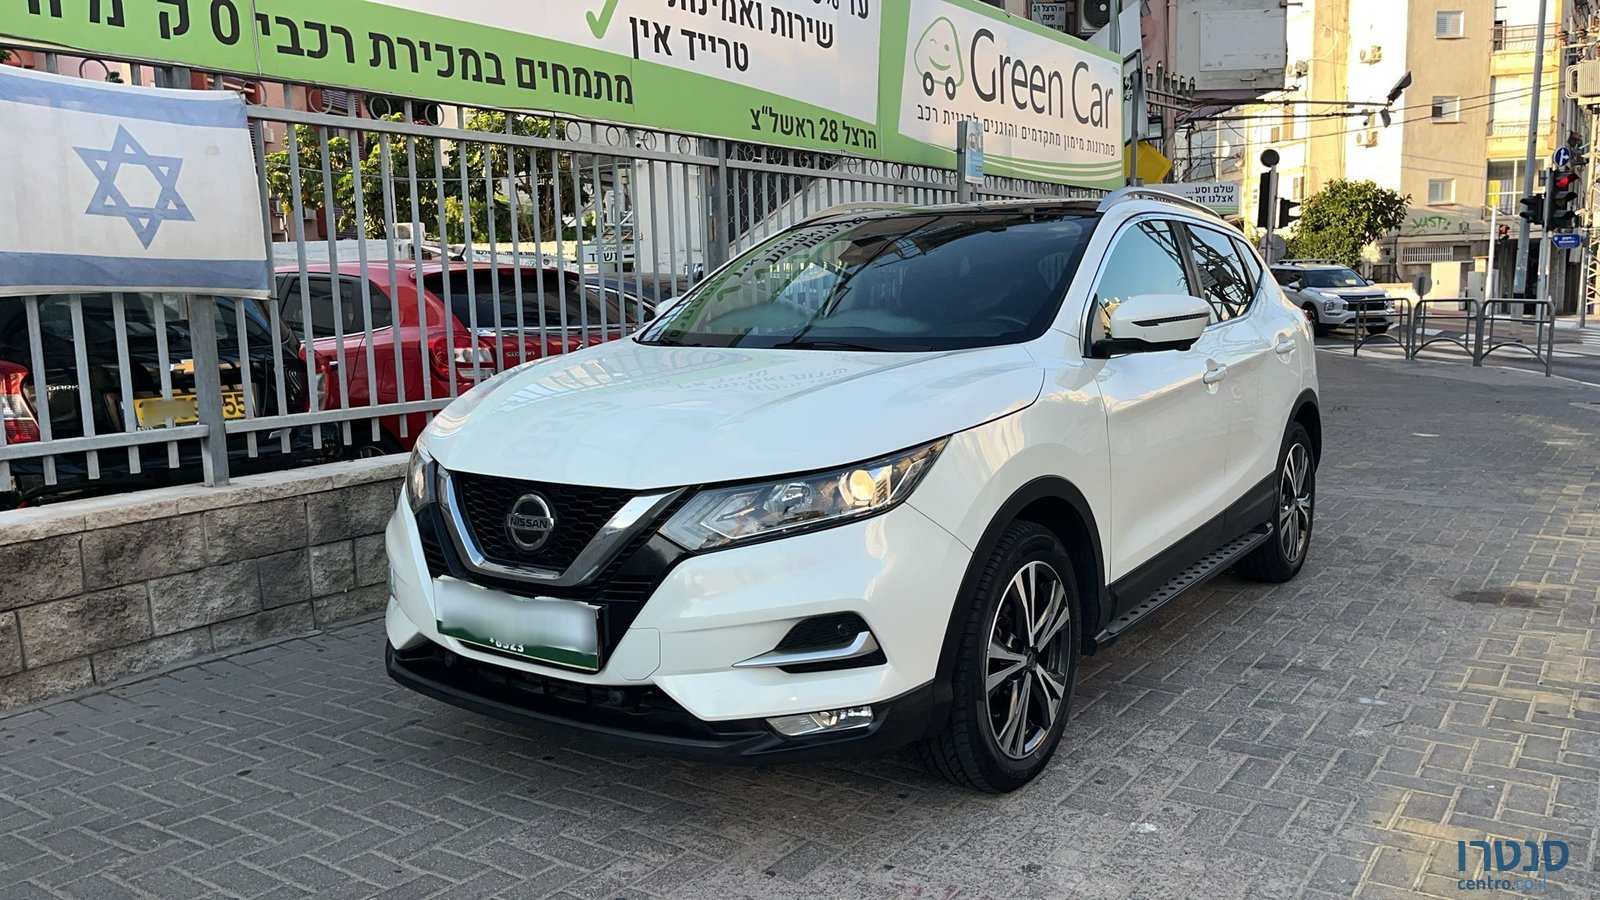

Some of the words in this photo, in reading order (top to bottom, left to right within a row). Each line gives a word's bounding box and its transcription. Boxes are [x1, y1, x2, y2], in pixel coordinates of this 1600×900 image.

[256, 12, 355, 64] רכבי
[629, 16, 672, 60] אין
[770, 6, 833, 49] שירות
[368, 31, 506, 86] במכירת
[681, 28, 749, 72] טרייד
[515, 57, 633, 104] מתמחים
[970, 28, 1064, 119] Green
[1071, 61, 1114, 129] Car
[917, 104, 939, 123] רכב
[820, 117, 838, 142] 28
[842, 120, 877, 149] הרצל
[983, 118, 1018, 138] והוגנים
[1021, 126, 1061, 147] מתקדמים
[1063, 134, 1084, 151] מימון
[1086, 139, 1116, 157] פתרונות
[1208, 194, 1234, 203] אצלנו
[1213, 184, 1234, 194] שלם
[510, 516, 548, 529] NISSAN
